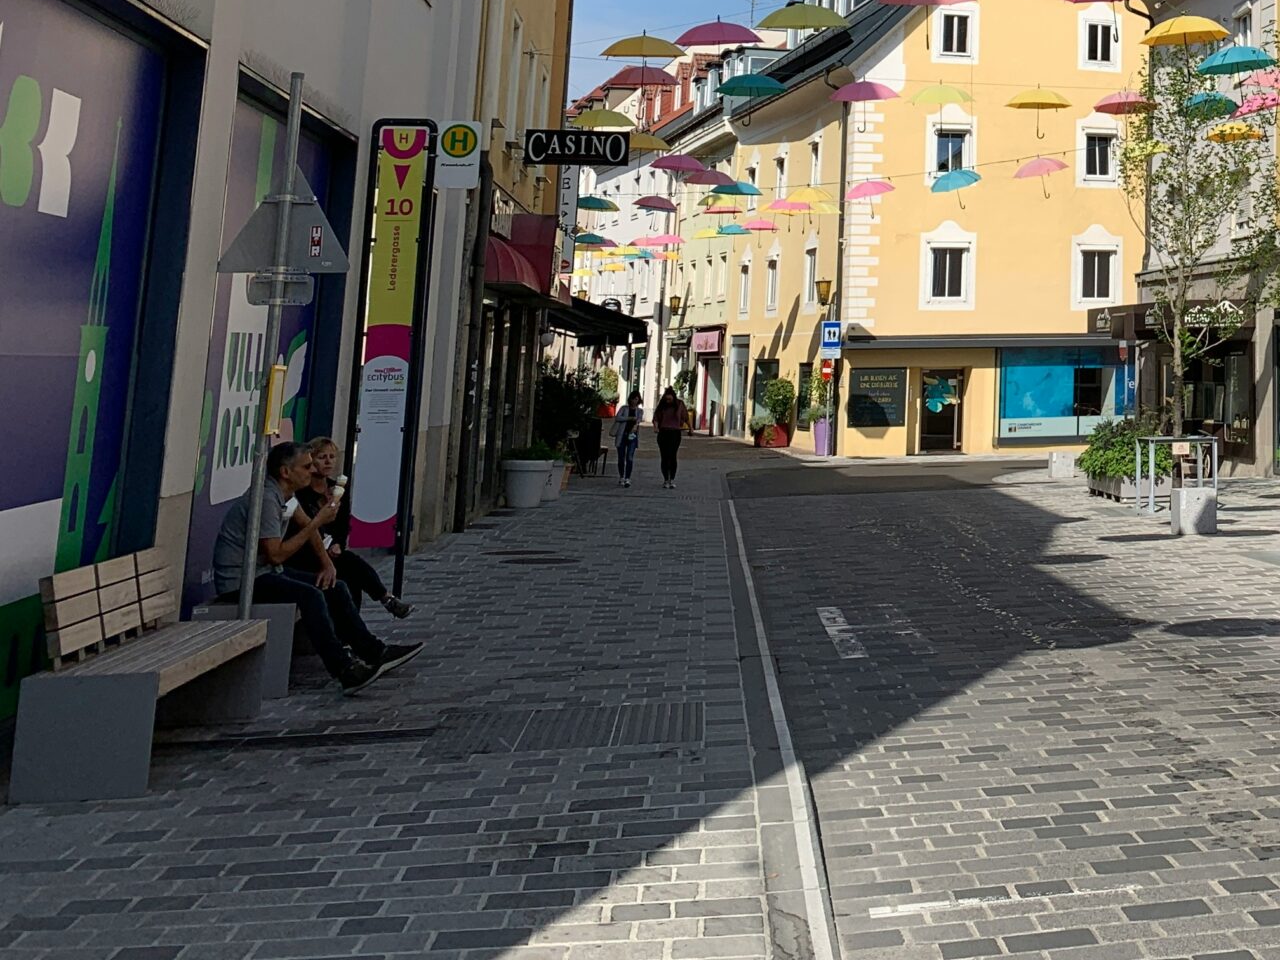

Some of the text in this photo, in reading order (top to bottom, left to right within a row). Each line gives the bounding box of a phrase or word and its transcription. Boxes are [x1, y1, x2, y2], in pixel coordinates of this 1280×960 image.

[451, 131, 469, 151] H
[528, 132, 626, 162] CASINO
[385, 198, 414, 216] 10
[387, 225, 401, 291] Lederergasse
